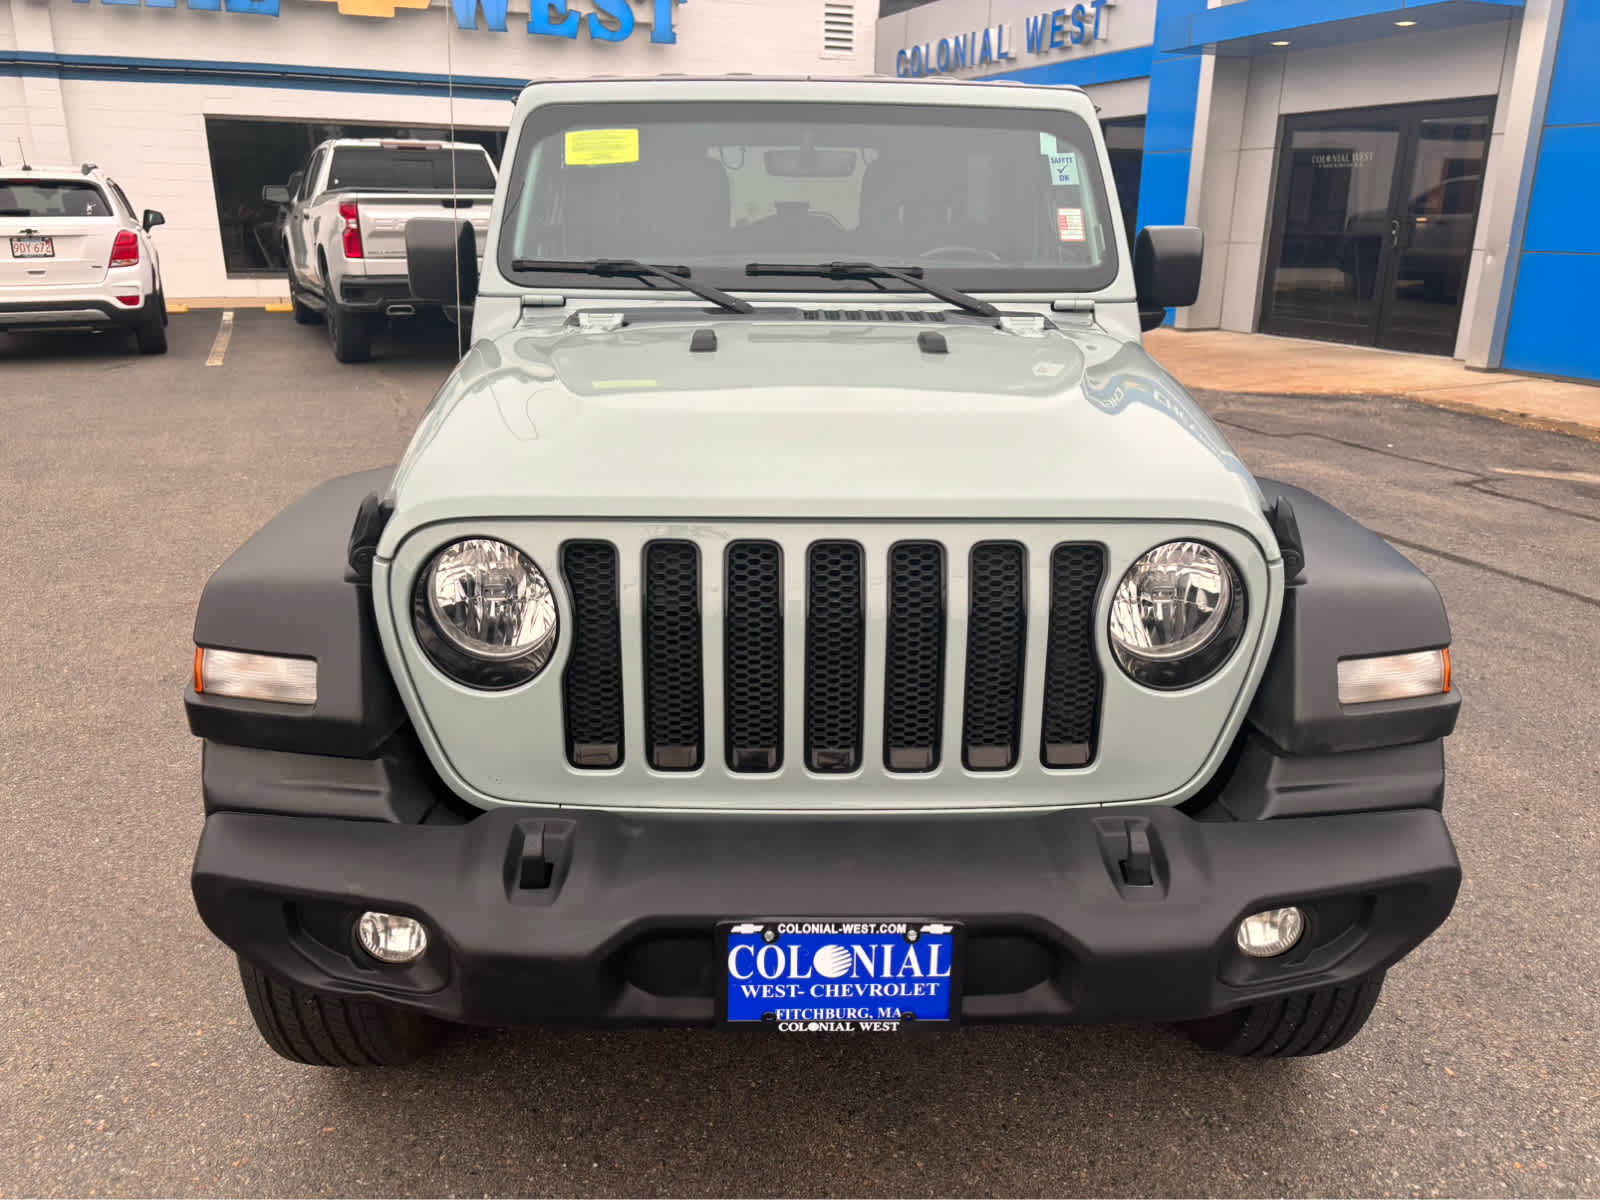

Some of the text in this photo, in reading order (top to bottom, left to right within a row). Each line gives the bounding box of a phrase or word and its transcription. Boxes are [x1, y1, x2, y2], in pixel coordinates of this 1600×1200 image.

[896, 0, 1107, 78] COLONIAL WEST
[777, 923, 907, 935] COLONIAL-WEST.COM
[728, 944, 951, 980] COLONIAL
[810, 982, 940, 998] CHEVROLET
[878, 1007, 902, 1019] MA
[778, 1022, 900, 1032] COLONIAL WEST
